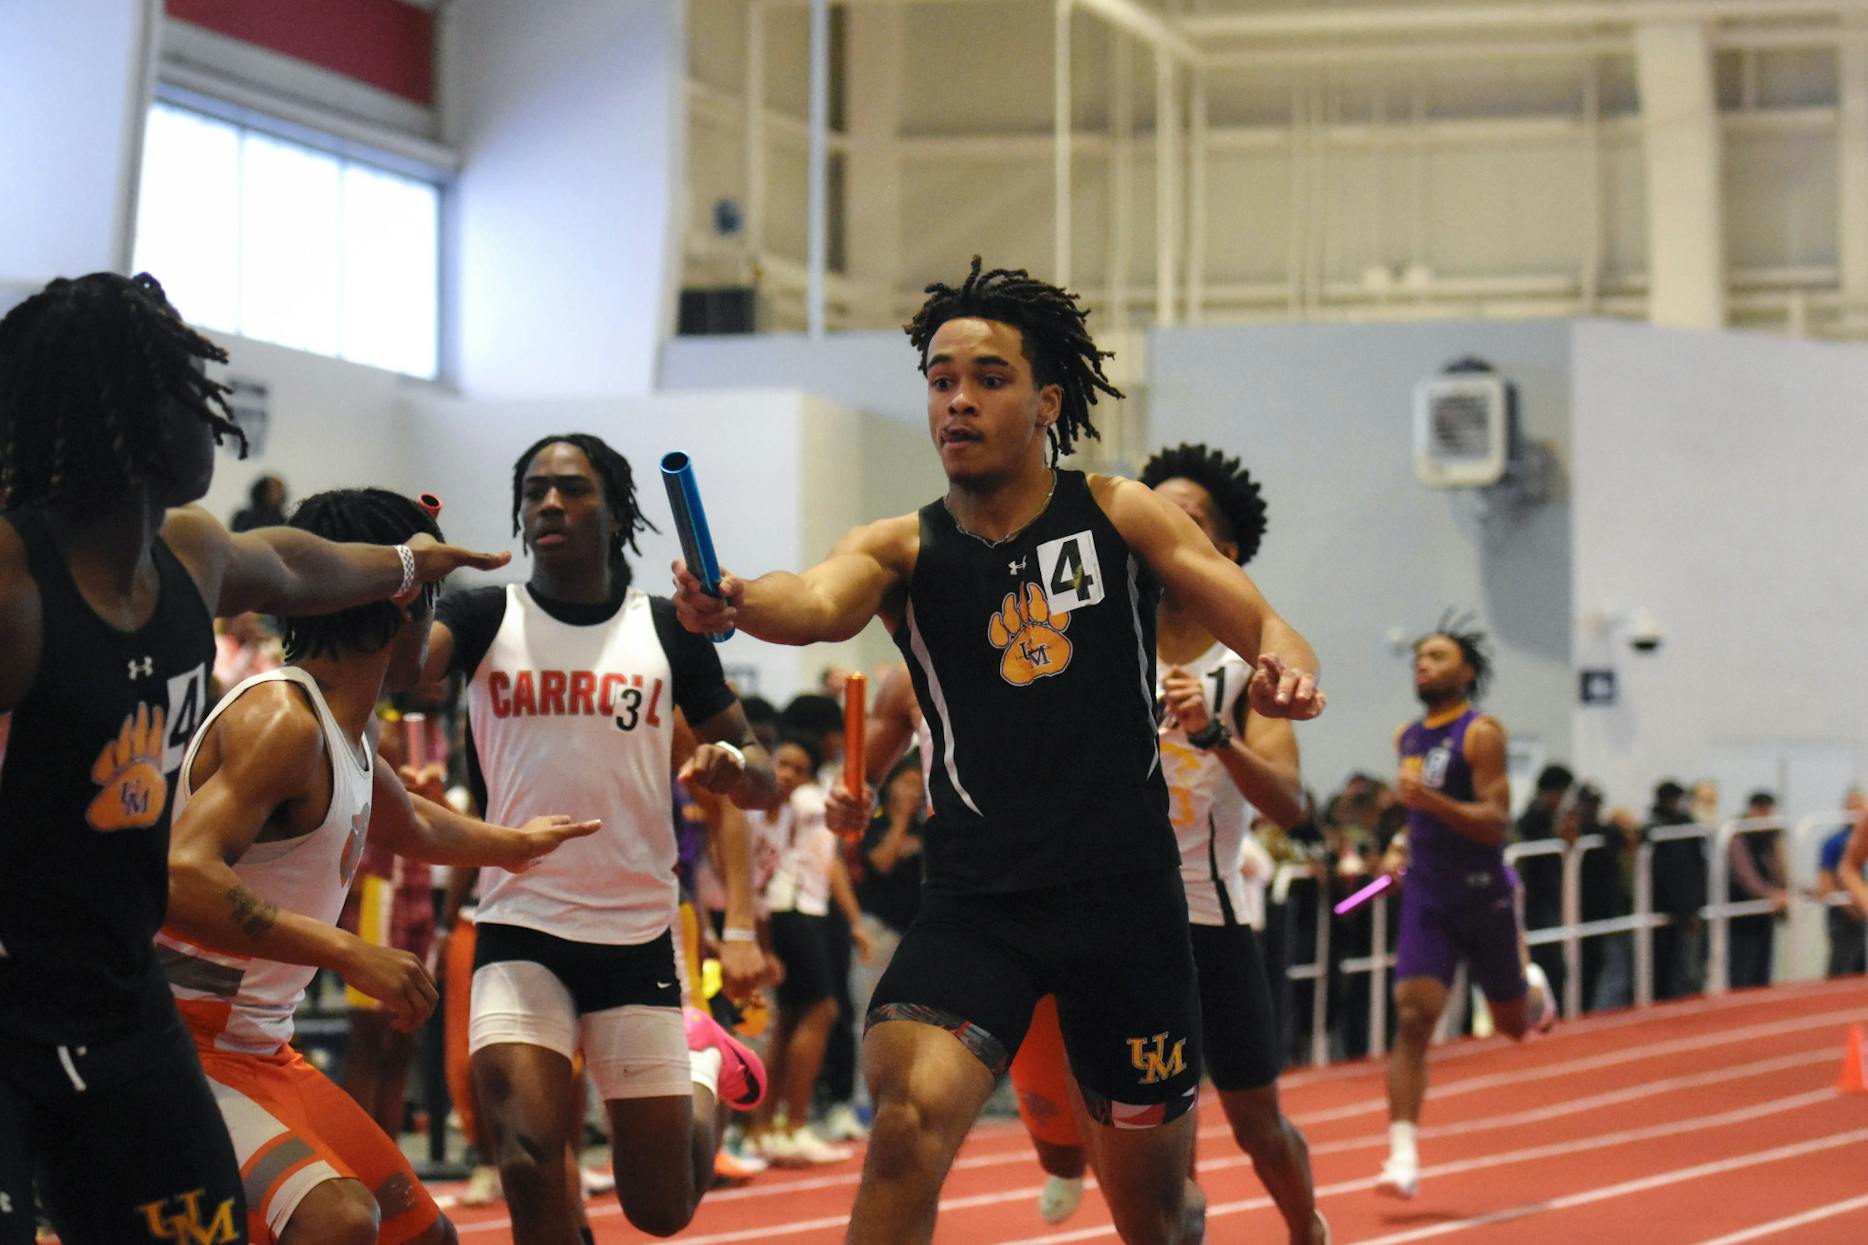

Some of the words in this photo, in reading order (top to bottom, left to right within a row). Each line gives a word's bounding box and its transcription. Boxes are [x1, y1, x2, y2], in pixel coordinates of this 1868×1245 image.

[1051, 538, 1094, 601] 4
[489, 670, 663, 728] CARROL
[616, 688, 641, 731] 3
[1206, 666, 1226, 713] 1
[1126, 1031, 1187, 1084] UM
